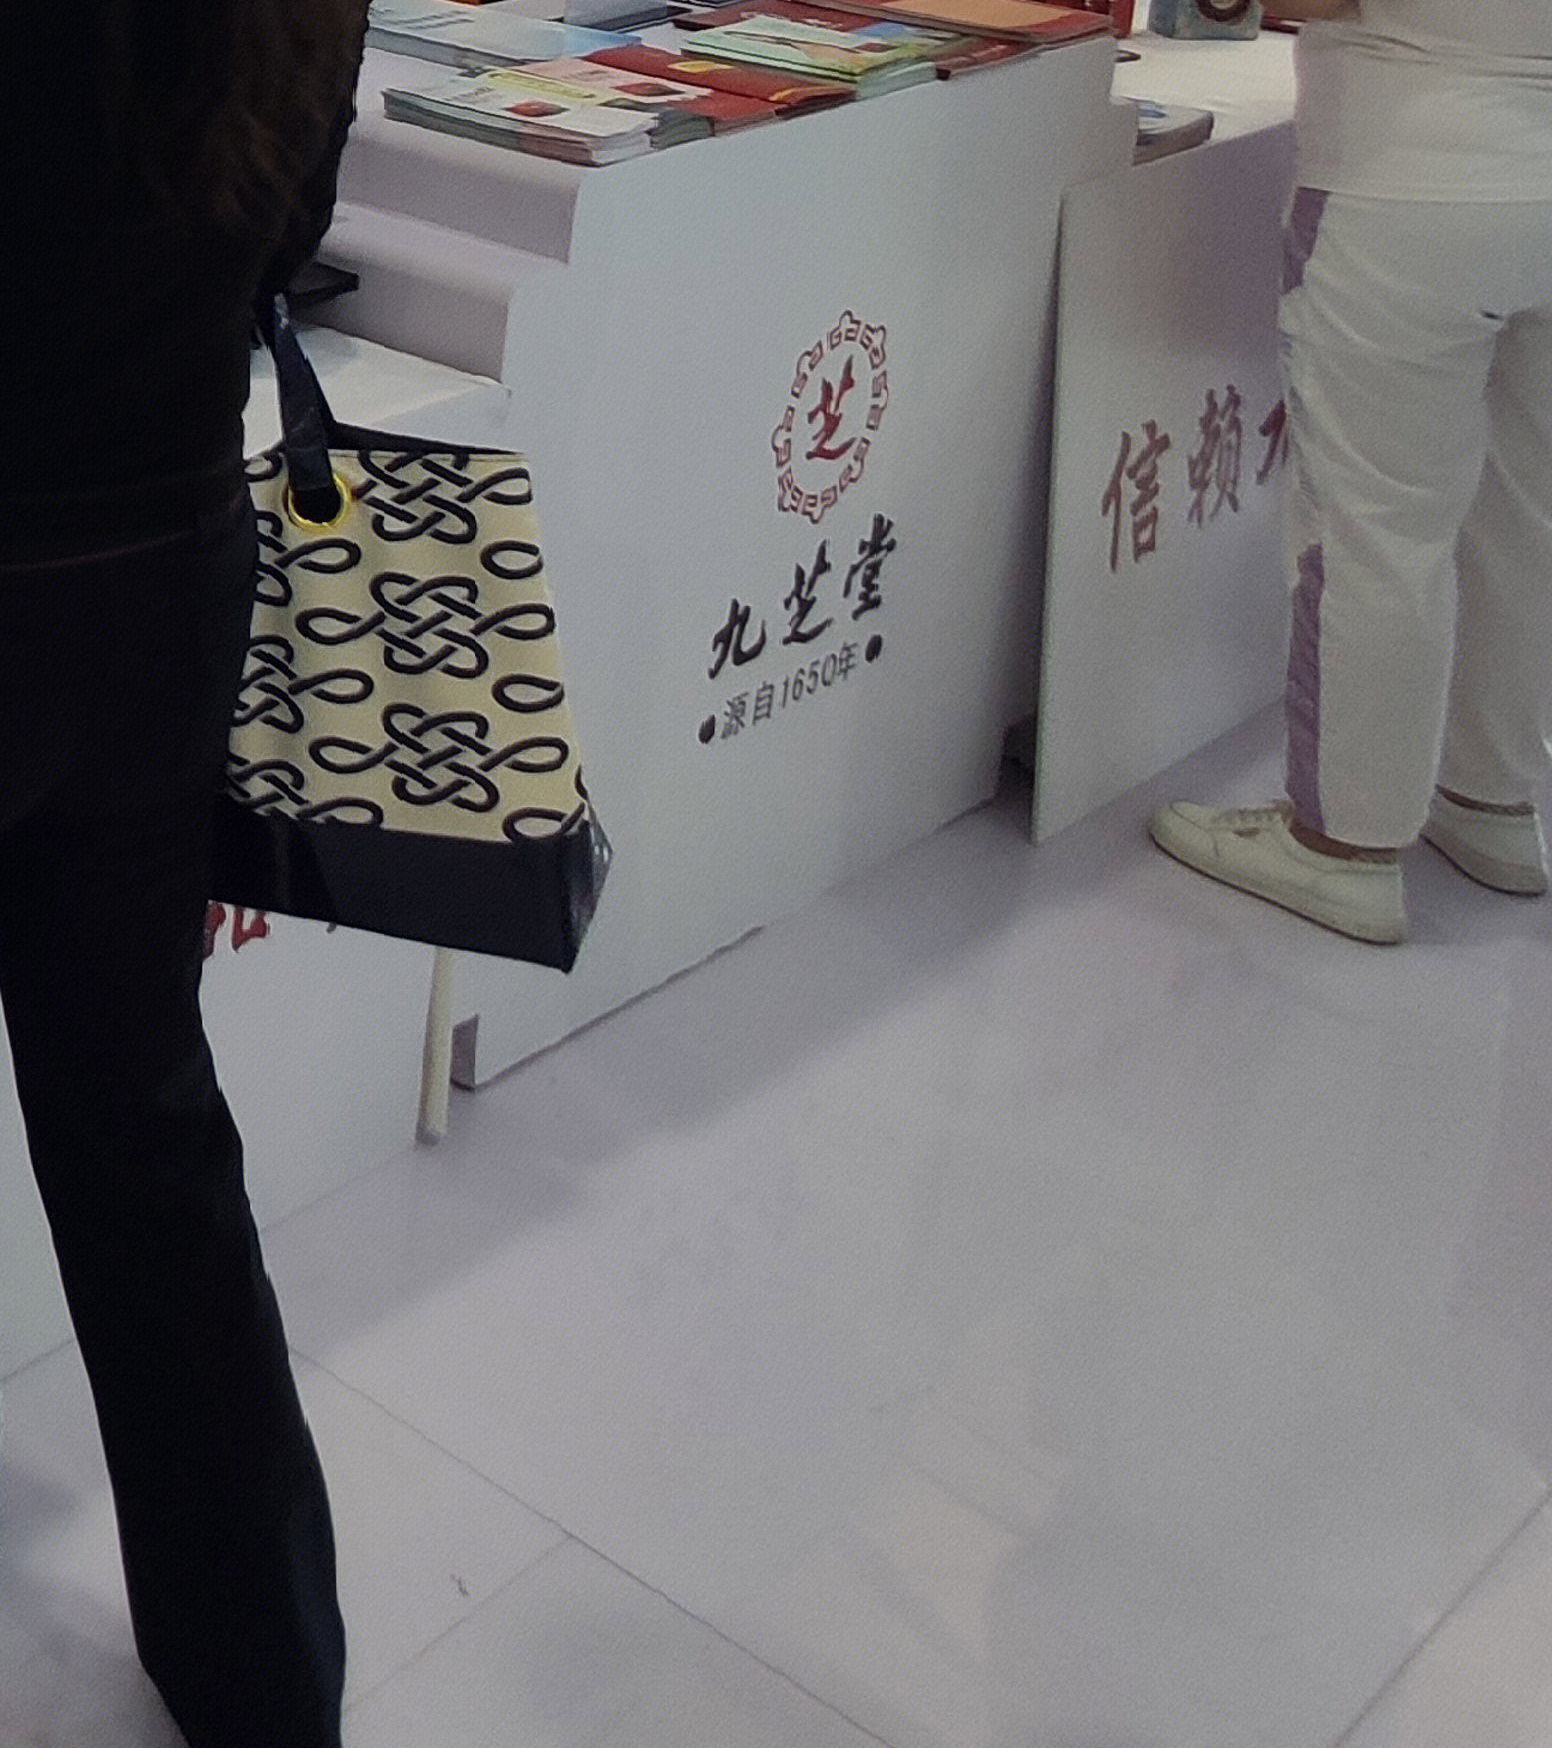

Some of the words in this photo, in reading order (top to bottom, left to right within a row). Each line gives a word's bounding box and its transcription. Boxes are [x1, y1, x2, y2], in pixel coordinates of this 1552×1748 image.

[806, 354, 858, 462] 芝
[707, 512, 898, 681] 九芝堂
[719, 640, 859, 741] 源自1650年
